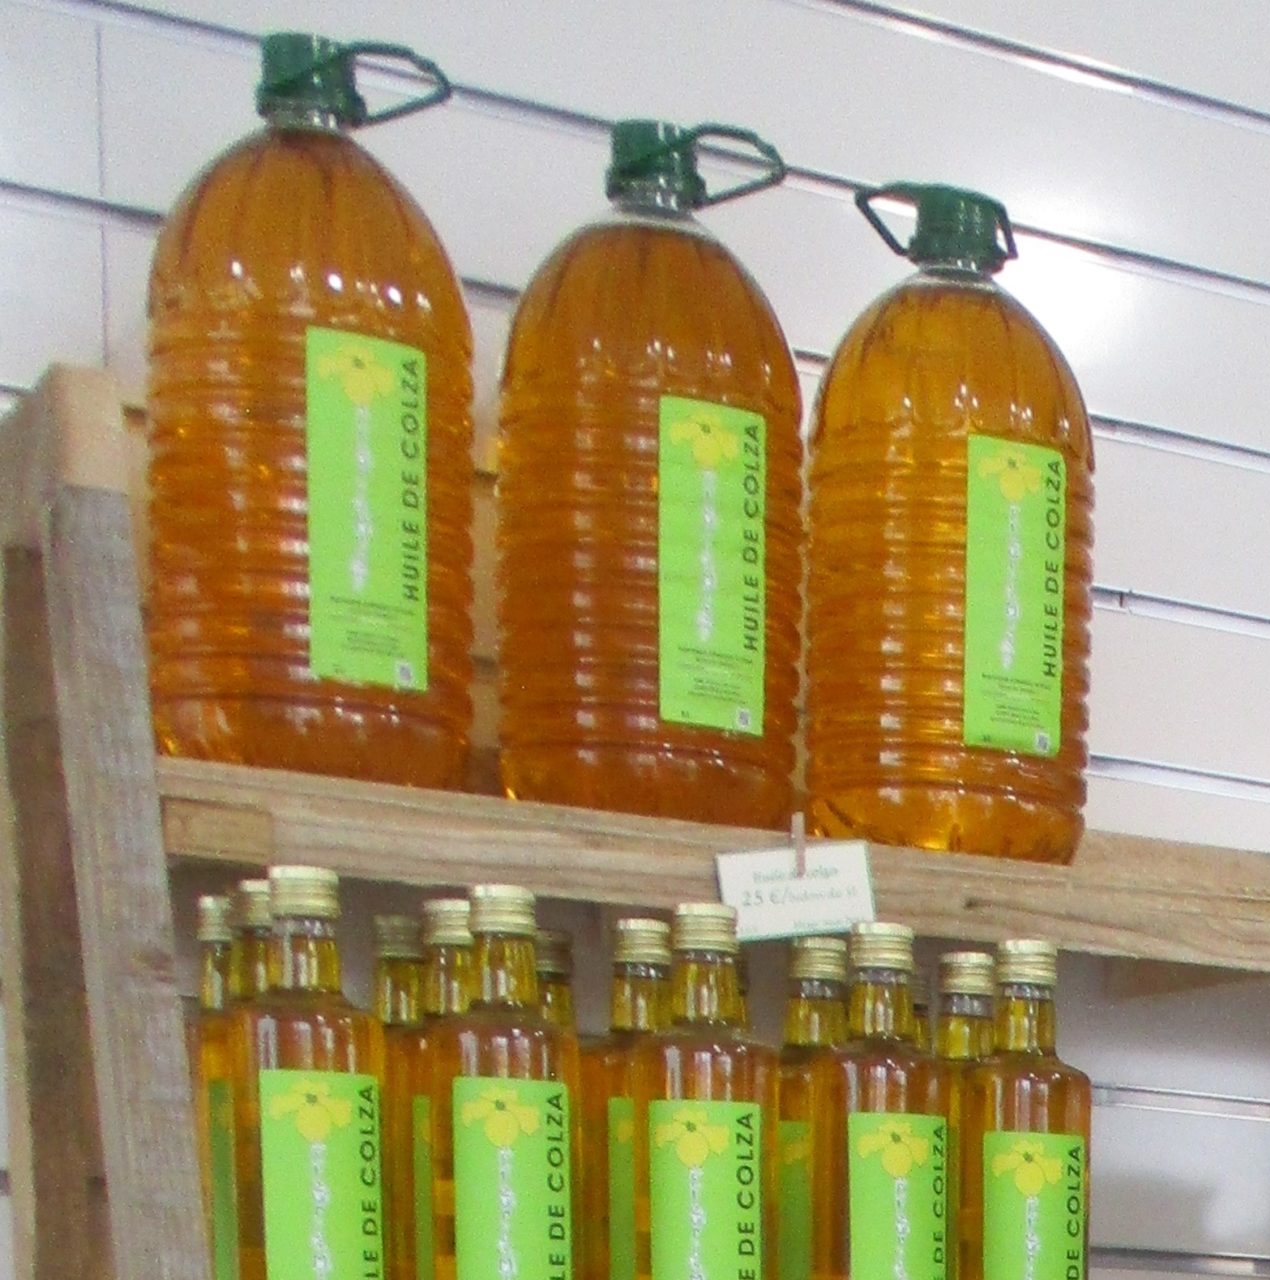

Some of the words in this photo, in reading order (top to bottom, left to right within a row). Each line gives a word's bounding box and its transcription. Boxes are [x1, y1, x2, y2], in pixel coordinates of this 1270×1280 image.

[401, 359, 420, 460] COLZA
[401, 471, 420, 510] DE
[743, 425, 759, 520] COLZA
[1045, 460, 1061, 551] COLZA
[402, 520, 420, 602] HUILE
[742, 529, 759, 566] DE
[1044, 561, 1059, 595] DE
[743, 575, 760, 652] HUILE
[1043, 605, 1058, 678] HUILE
[358, 1084, 377, 1188] COLZA
[546, 1093, 565, 1193] COLZA
[736, 1112, 755, 1210] COLZA
[932, 1125, 944, 1218] COLZA
[361, 1202, 378, 1236] DE
[548, 1206, 566, 1241] DE
[1066, 1146, 1081, 1237] COLZA
[737, 1222, 755, 1257] DE
[932, 1231, 944, 1265] DE
